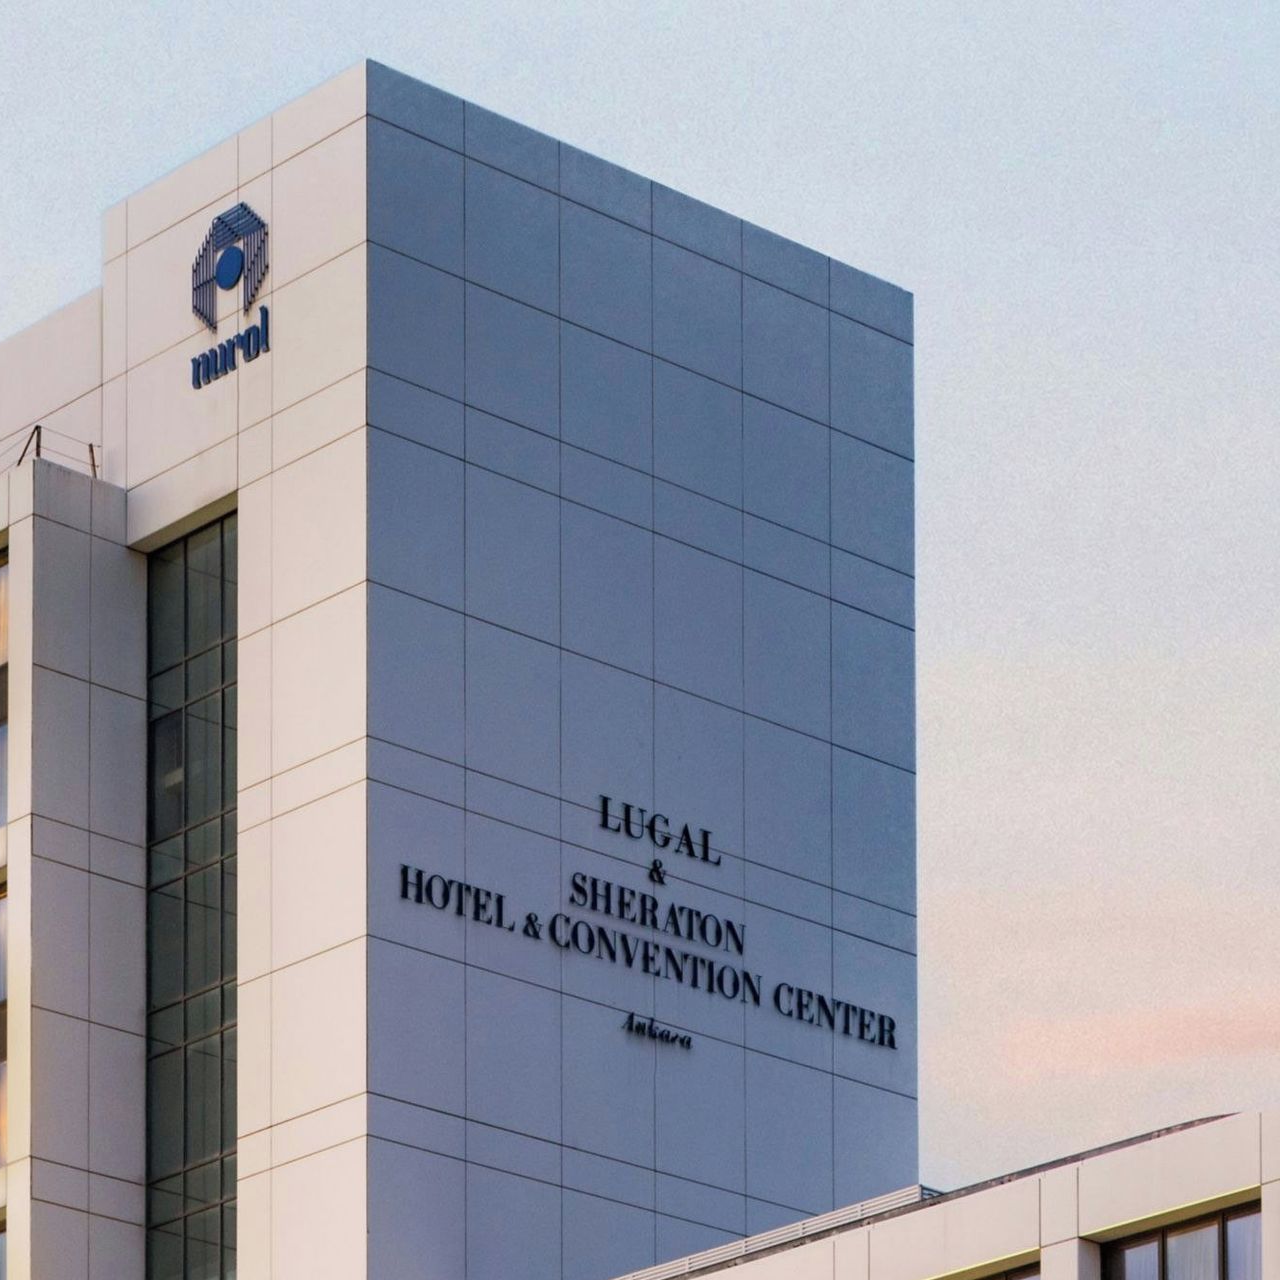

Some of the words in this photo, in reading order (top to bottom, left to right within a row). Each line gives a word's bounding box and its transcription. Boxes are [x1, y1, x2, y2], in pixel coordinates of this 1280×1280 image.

[191, 305, 270, 390] nurol
[598, 794, 722, 866] LUGAL
[648, 858, 668, 886] &
[568, 871, 747, 956] SHERATON
[399, 863, 515, 932] HOTEL
[522, 912, 543, 941] &
[549, 912, 763, 1007] CONVENTION
[773, 982, 899, 1051] CENTER
